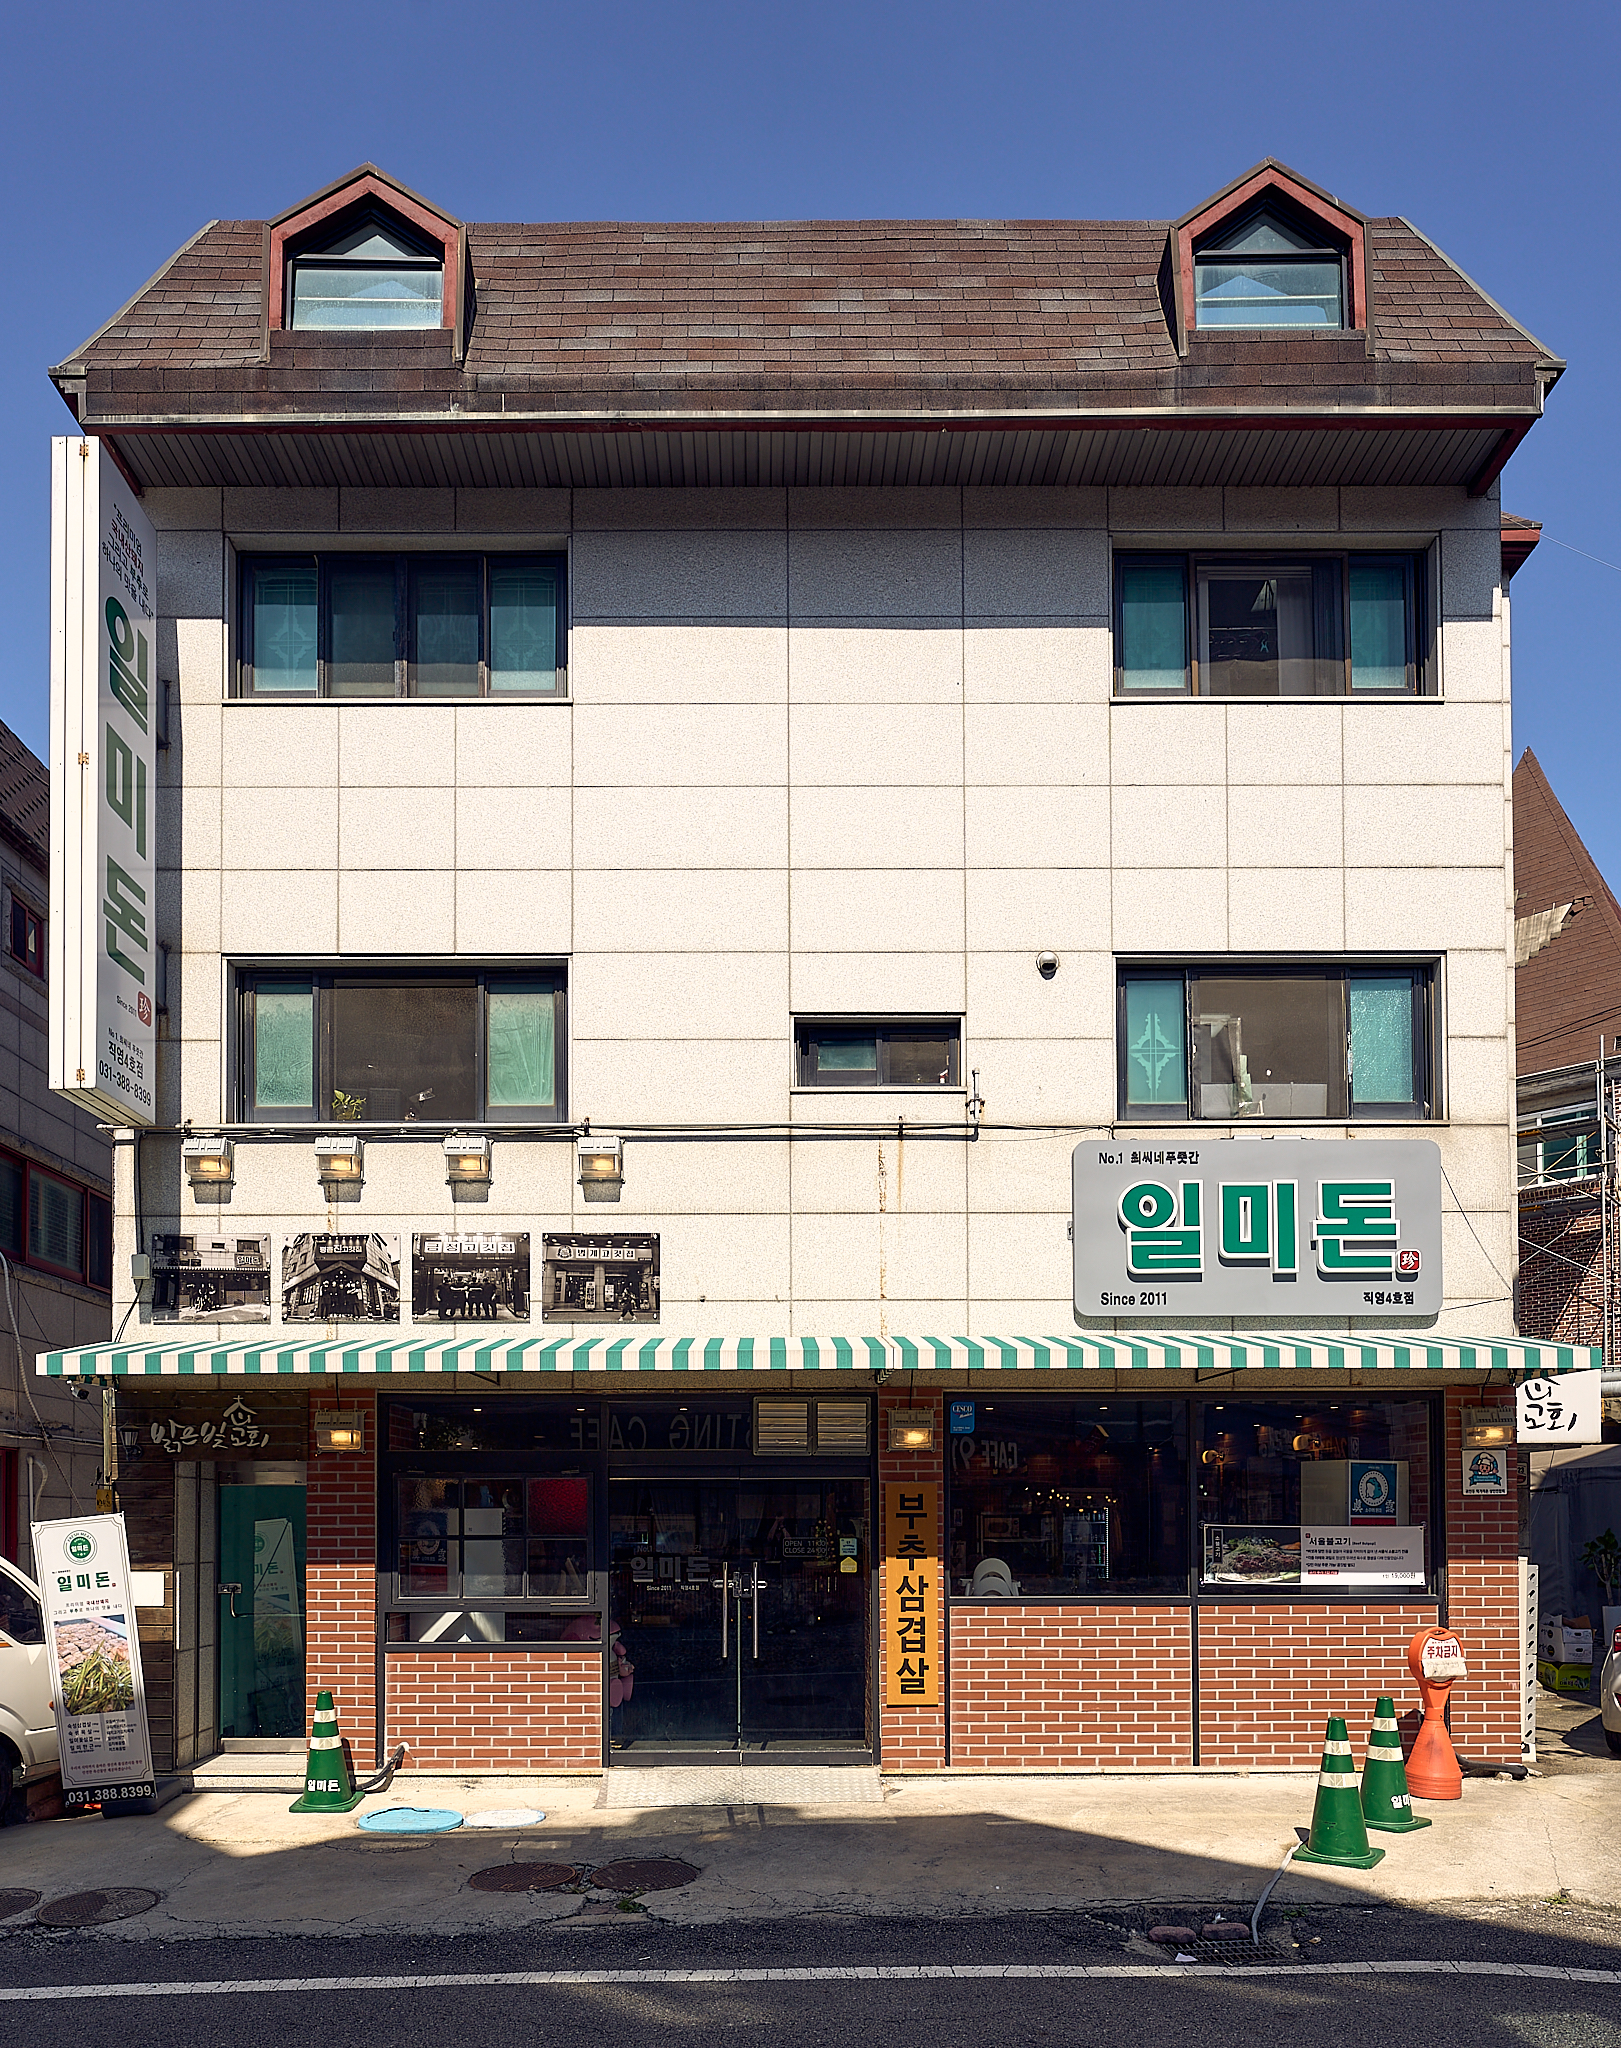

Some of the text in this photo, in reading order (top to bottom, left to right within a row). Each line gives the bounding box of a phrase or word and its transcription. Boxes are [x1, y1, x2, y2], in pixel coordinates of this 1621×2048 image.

[108, 1041, 144, 1080] 직영4호점
[99, 1060, 152, 1107] 031-388-8399
[1098, 1151, 1200, 1165] No.1 최씨네푸줏간
[1117, 1179, 1401, 1274] 일미돈
[1100, 1292, 1168, 1306] Since 2011
[1363, 1292, 1415, 1306] 직영4호점
[952, 1405, 973, 1413] CESCO
[1309, 1537, 1351, 1546] 서울불고기
[630, 1556, 711, 1583] 일미돈
[57, 1571, 110, 1592] 일미돈
[895, 1493, 930, 1695] 부추삼겹살
[1427, 1645, 1458, 1659] 주차금지
[68, 1785, 152, 1804] 031.388.8399
